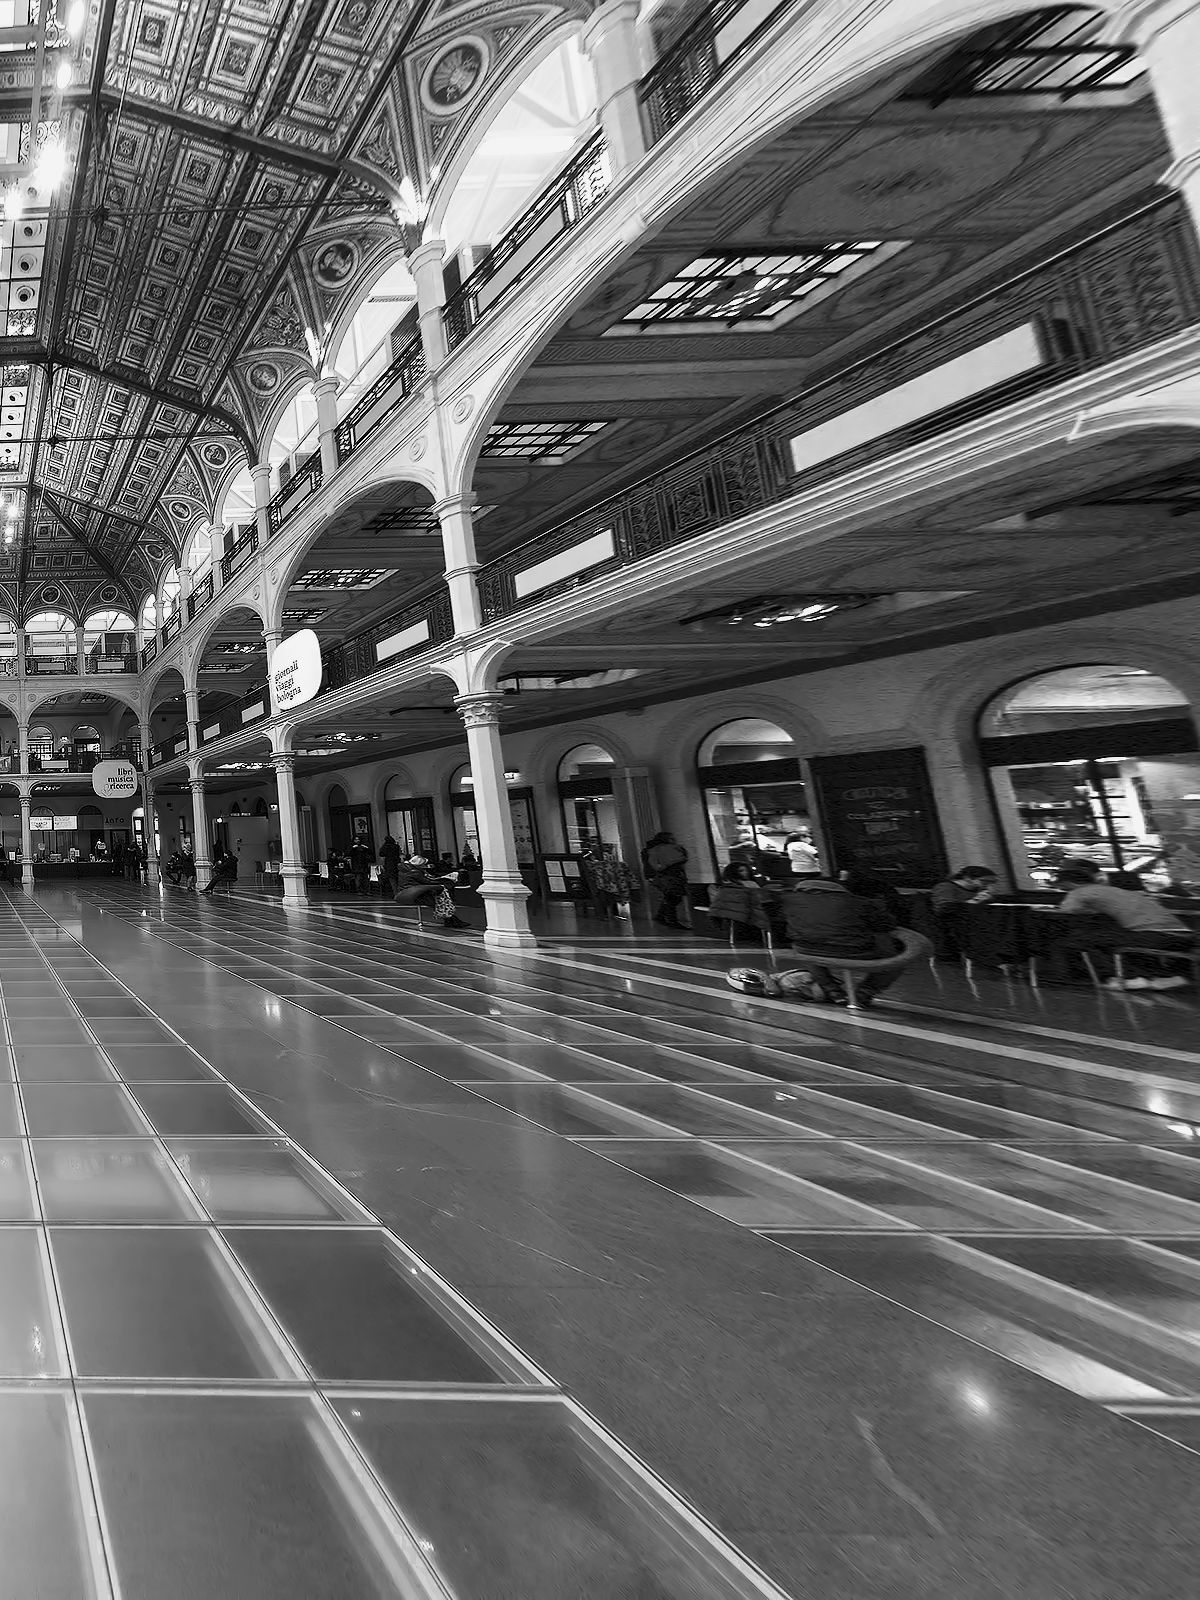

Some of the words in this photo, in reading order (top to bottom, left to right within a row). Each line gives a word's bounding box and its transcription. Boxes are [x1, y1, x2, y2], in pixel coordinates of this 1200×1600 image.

[274, 659, 299, 682] giornali
[275, 674, 295, 692] viaggi
[276, 686, 302, 703] bologna
[117, 767, 133, 776] libri
